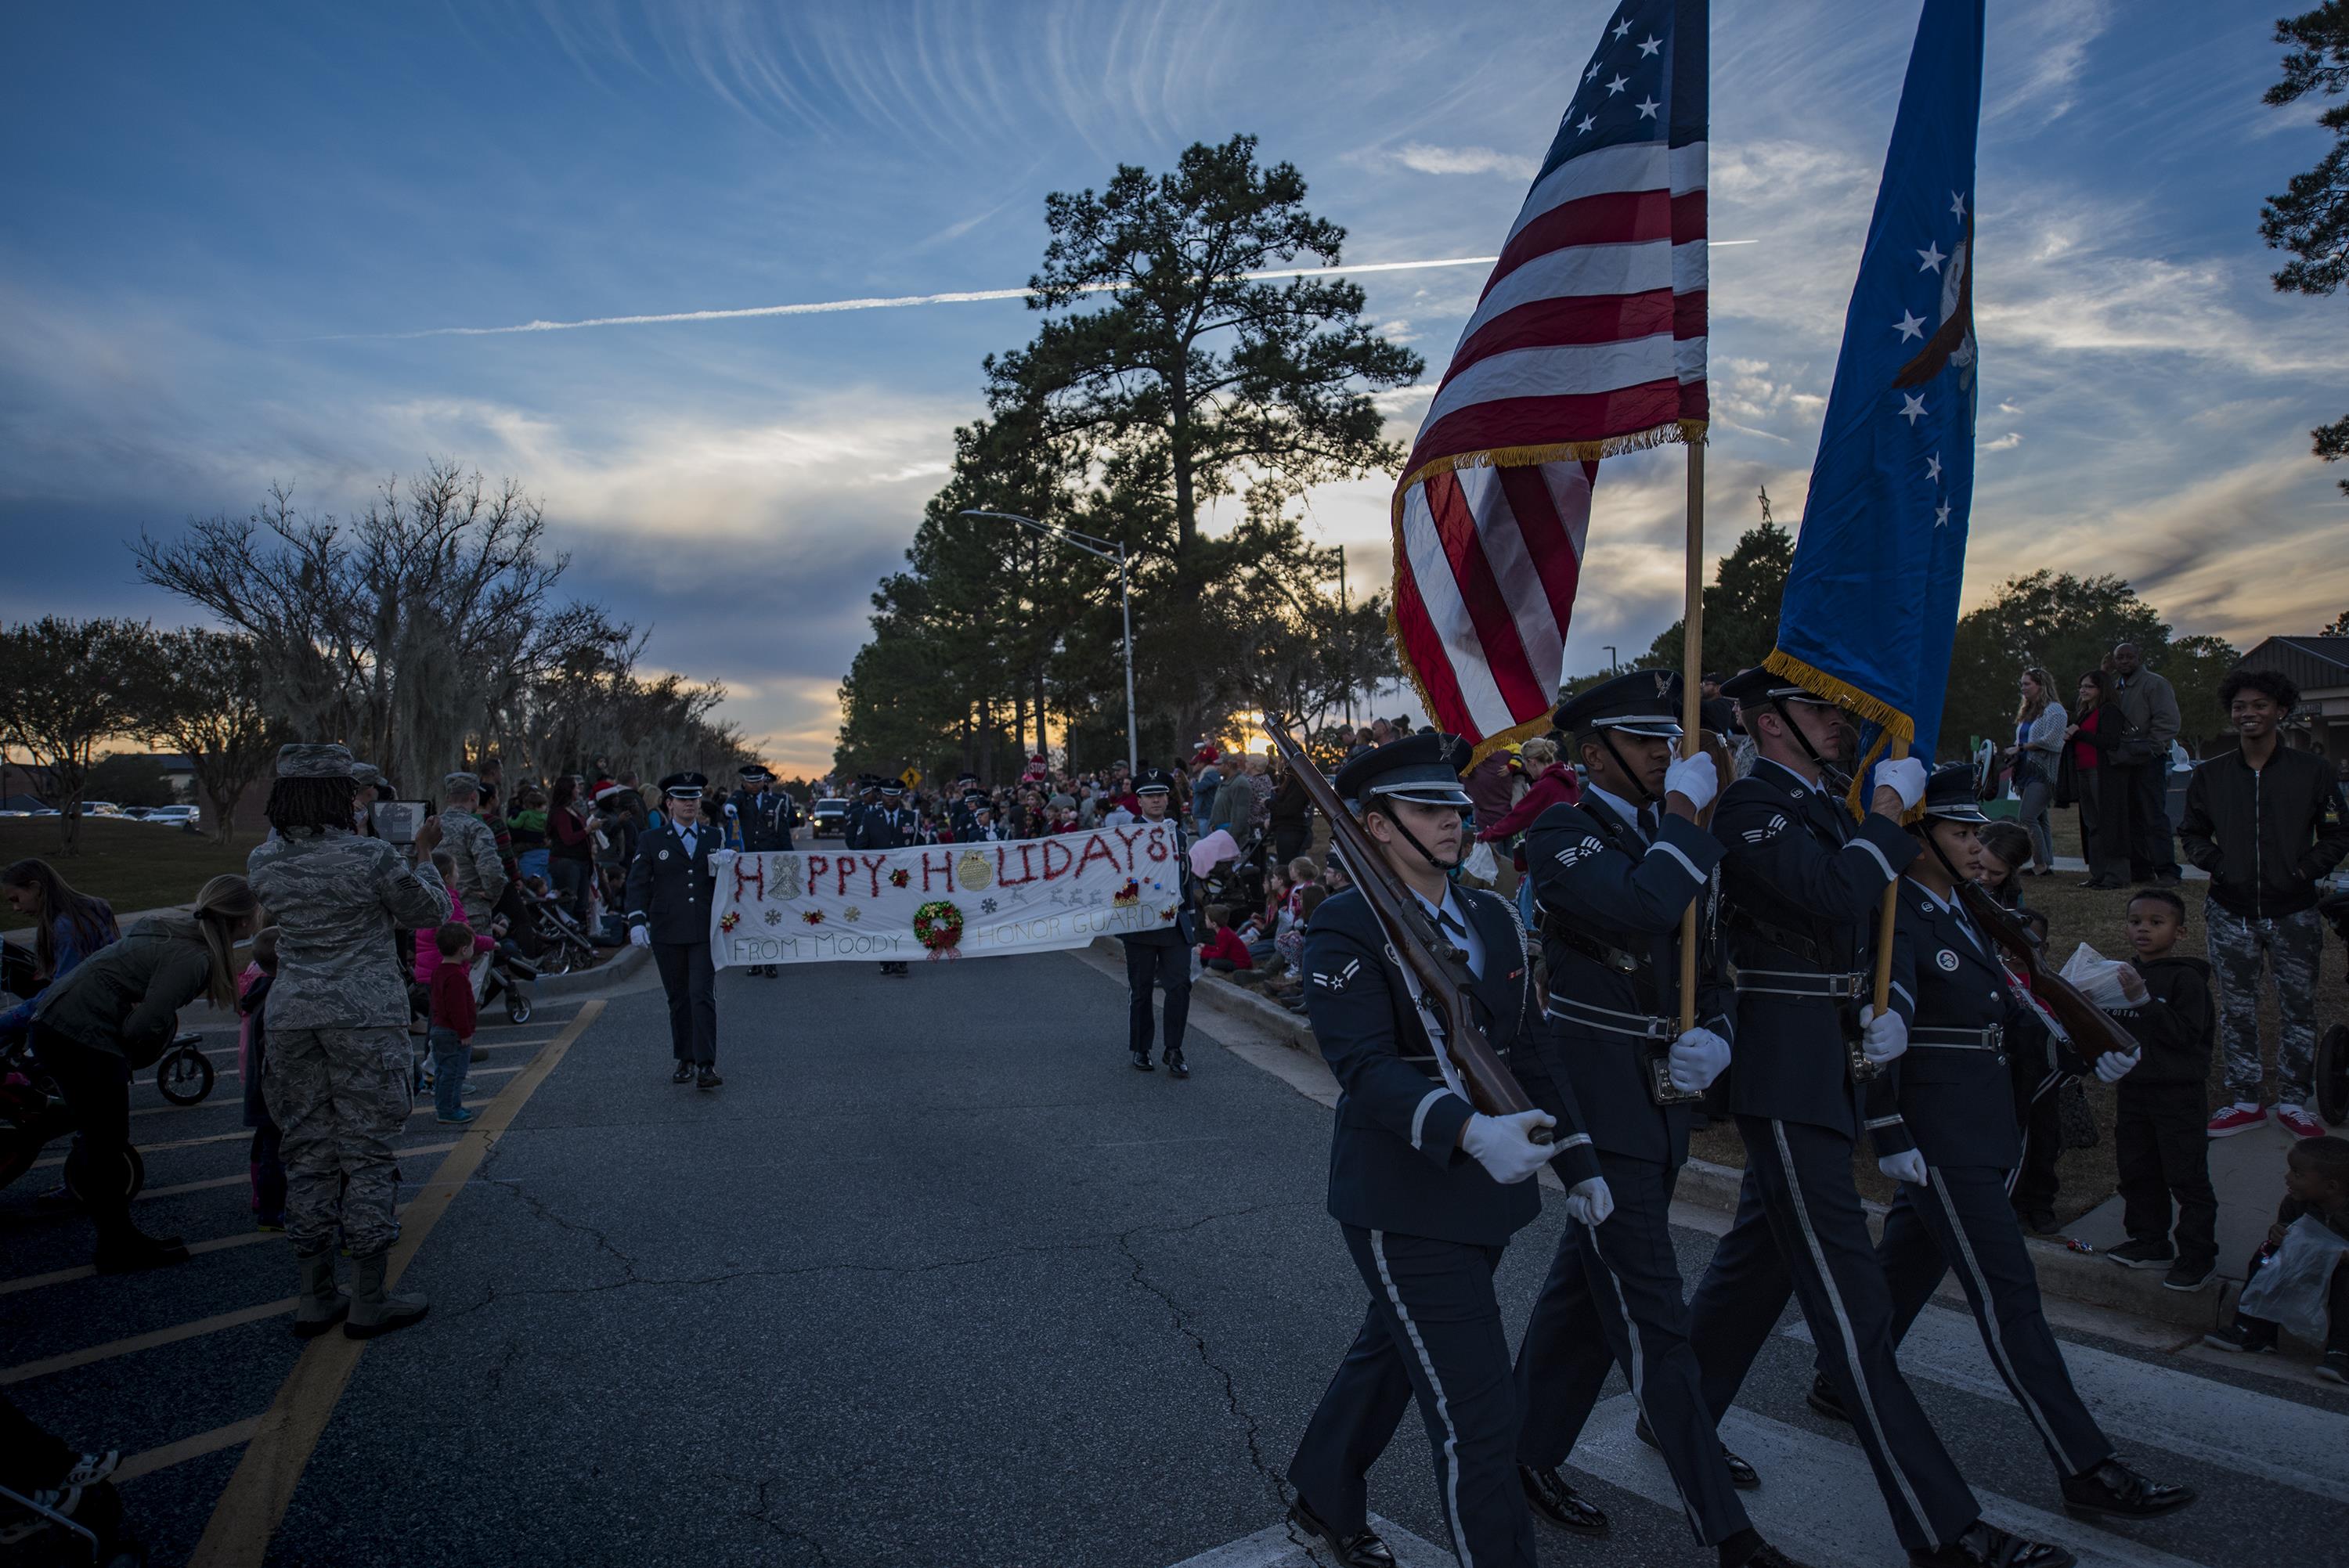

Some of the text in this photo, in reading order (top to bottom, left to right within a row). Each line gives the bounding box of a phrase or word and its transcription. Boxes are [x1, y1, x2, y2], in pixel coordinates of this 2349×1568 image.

[1030, 762, 1046, 773] STOP
[734, 903, 1156, 962] FROM MOODY HONOR GUARD
